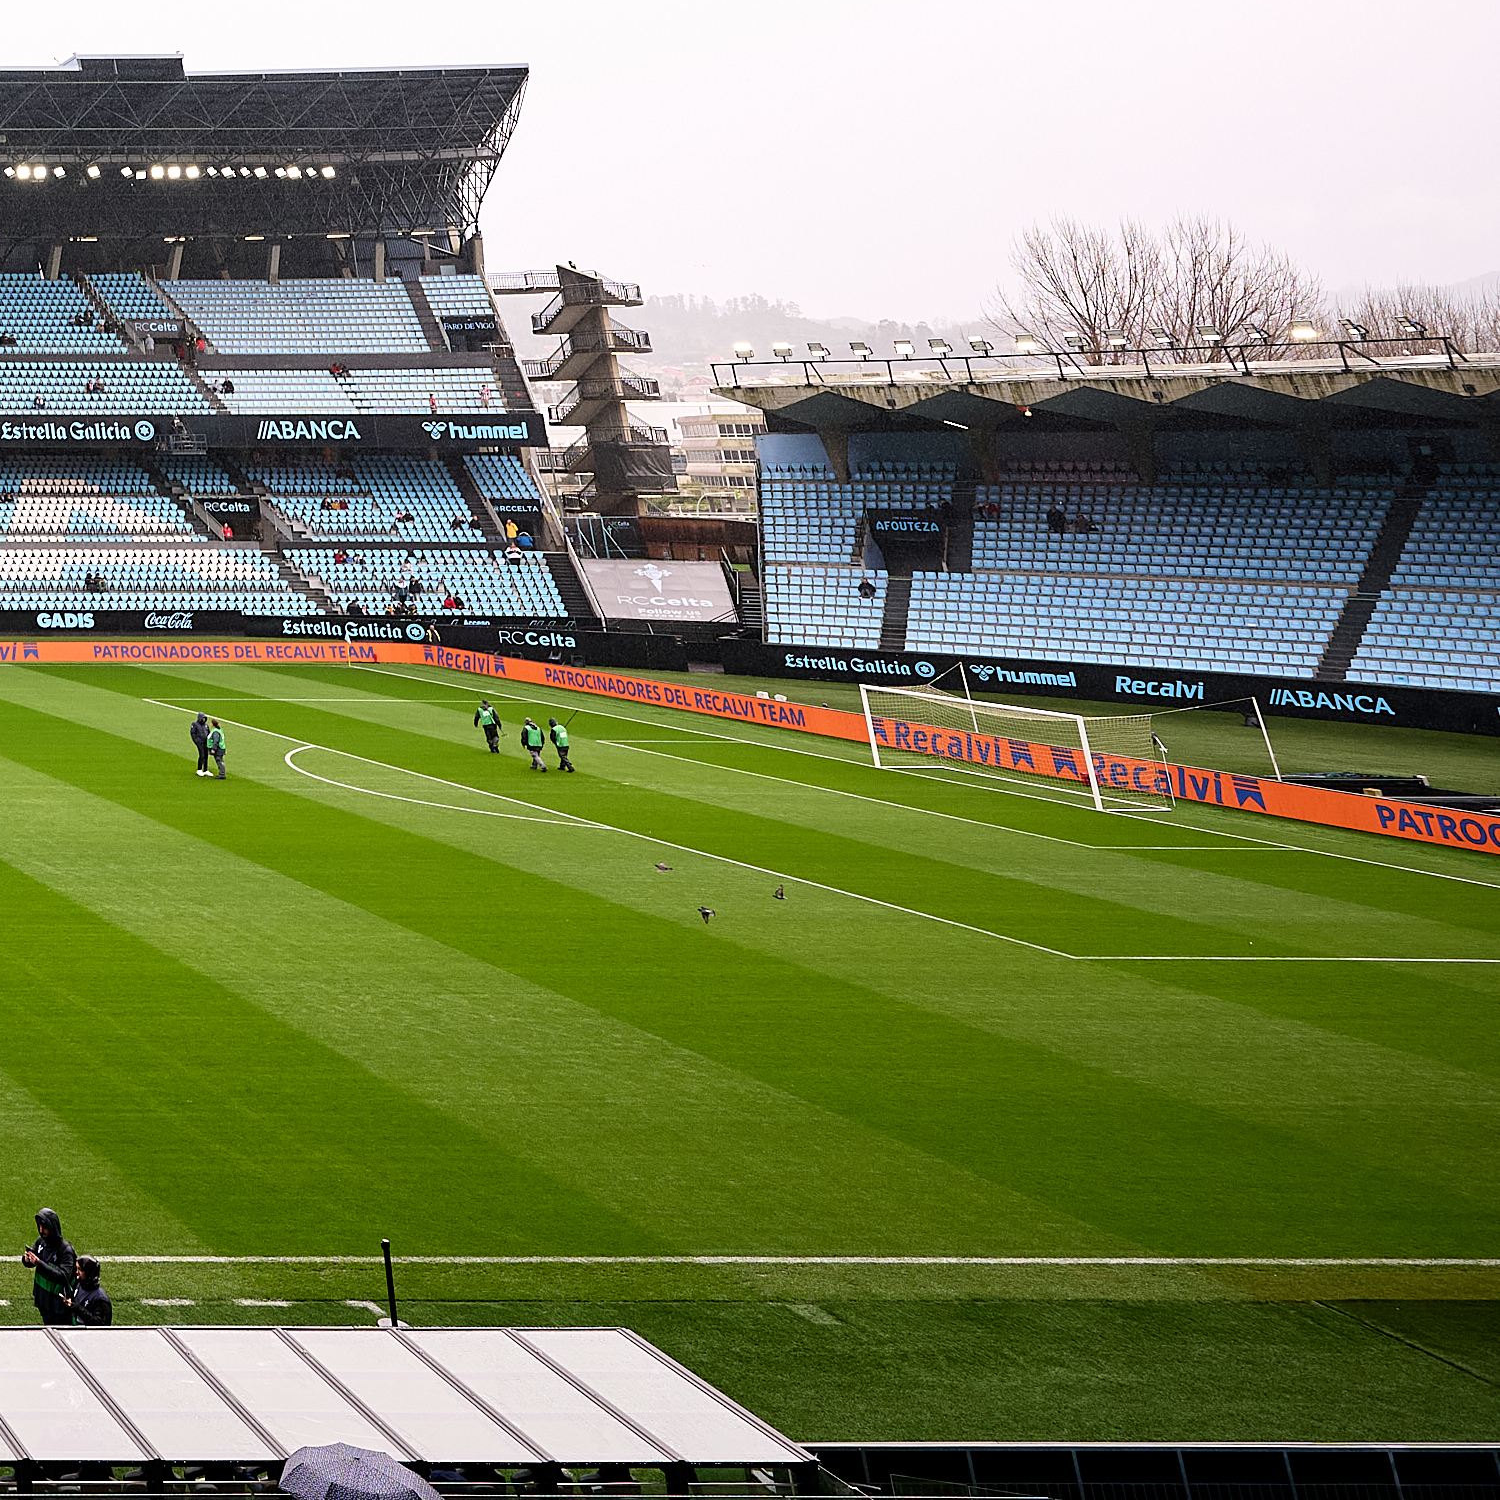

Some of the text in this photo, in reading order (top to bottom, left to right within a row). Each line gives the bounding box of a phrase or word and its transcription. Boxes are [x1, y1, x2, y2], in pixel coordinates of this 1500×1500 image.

[134, 322, 178, 332] RCCelta
[443, 322, 463, 330] FARO
[464, 322, 475, 330] DE
[1, 421, 131, 441] Estrella Galicia
[448, 420, 529, 440] hummel
[203, 501, 250, 512] RCCelta
[875, 520, 940, 532] AFOUTEZA
[617, 595, 714, 608] RCCelta
[36, 612, 95, 629] GADIS
[637, 607, 682, 616] Follow
[686, 609, 702, 617] us
[282, 619, 403, 639] Estrella Galicia
[498, 630, 576, 648] RCCelta
[93, 645, 375, 661] PATROCINADORES DEL RECALVI TEAM
[436, 646, 491, 677] Recalvi
[785, 653, 912, 676] Estrella Galicia
[996, 666, 1078, 688] hummel
[545, 666, 806, 727] PATROCINADORES DEL RECALVI TEAM
[1115, 675, 1205, 700] Recalvi
[895, 721, 1001, 765] Recalvi
[1090, 752, 1224, 805] Recalvi
